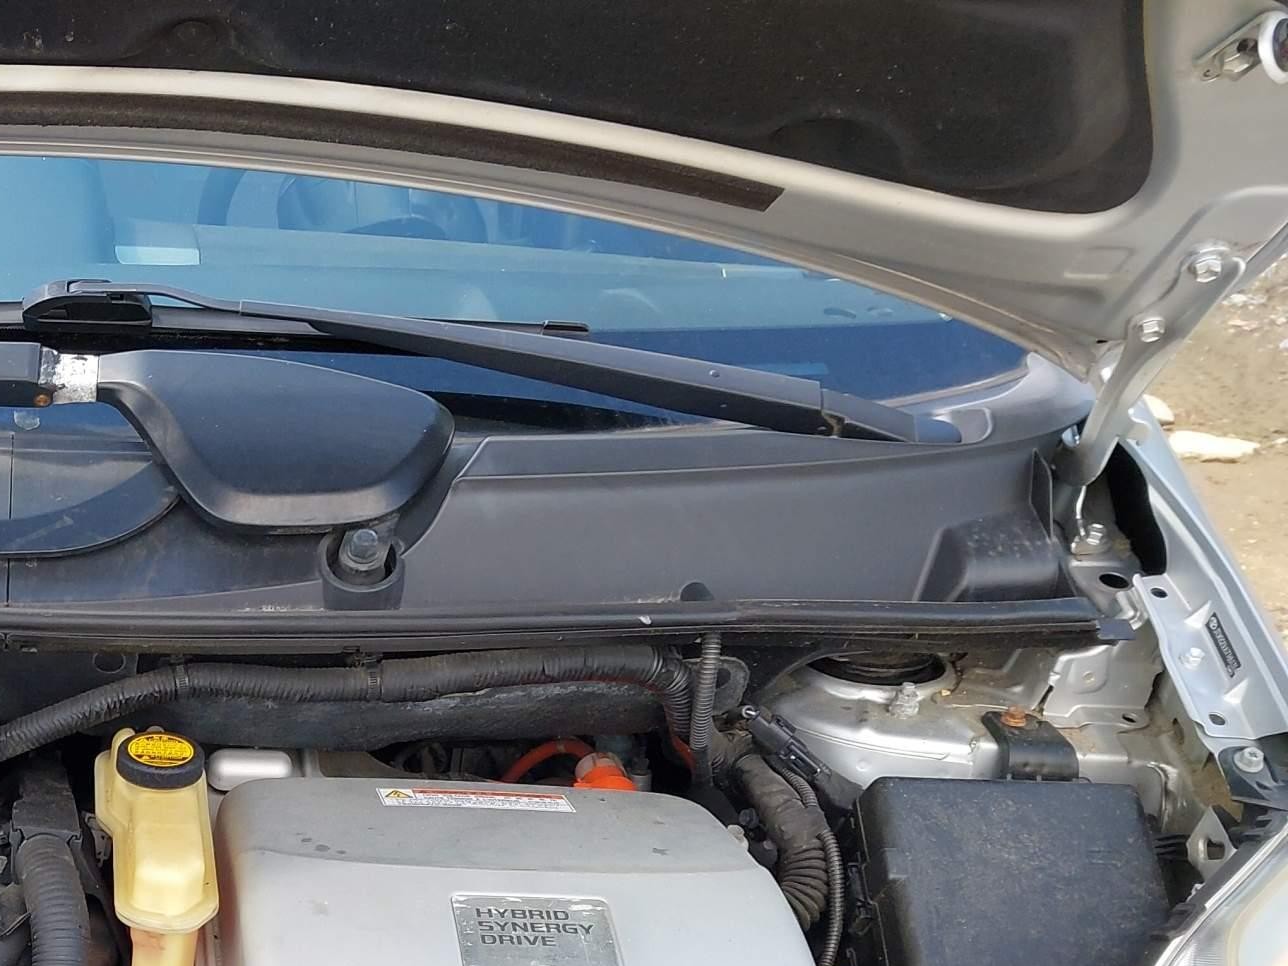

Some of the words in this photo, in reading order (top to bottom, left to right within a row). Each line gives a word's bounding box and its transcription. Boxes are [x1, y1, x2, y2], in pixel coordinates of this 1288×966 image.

[475, 908, 569, 920] HYBRID
[478, 921, 593, 935] SYNERGY
[481, 935, 557, 946] DRIVE
